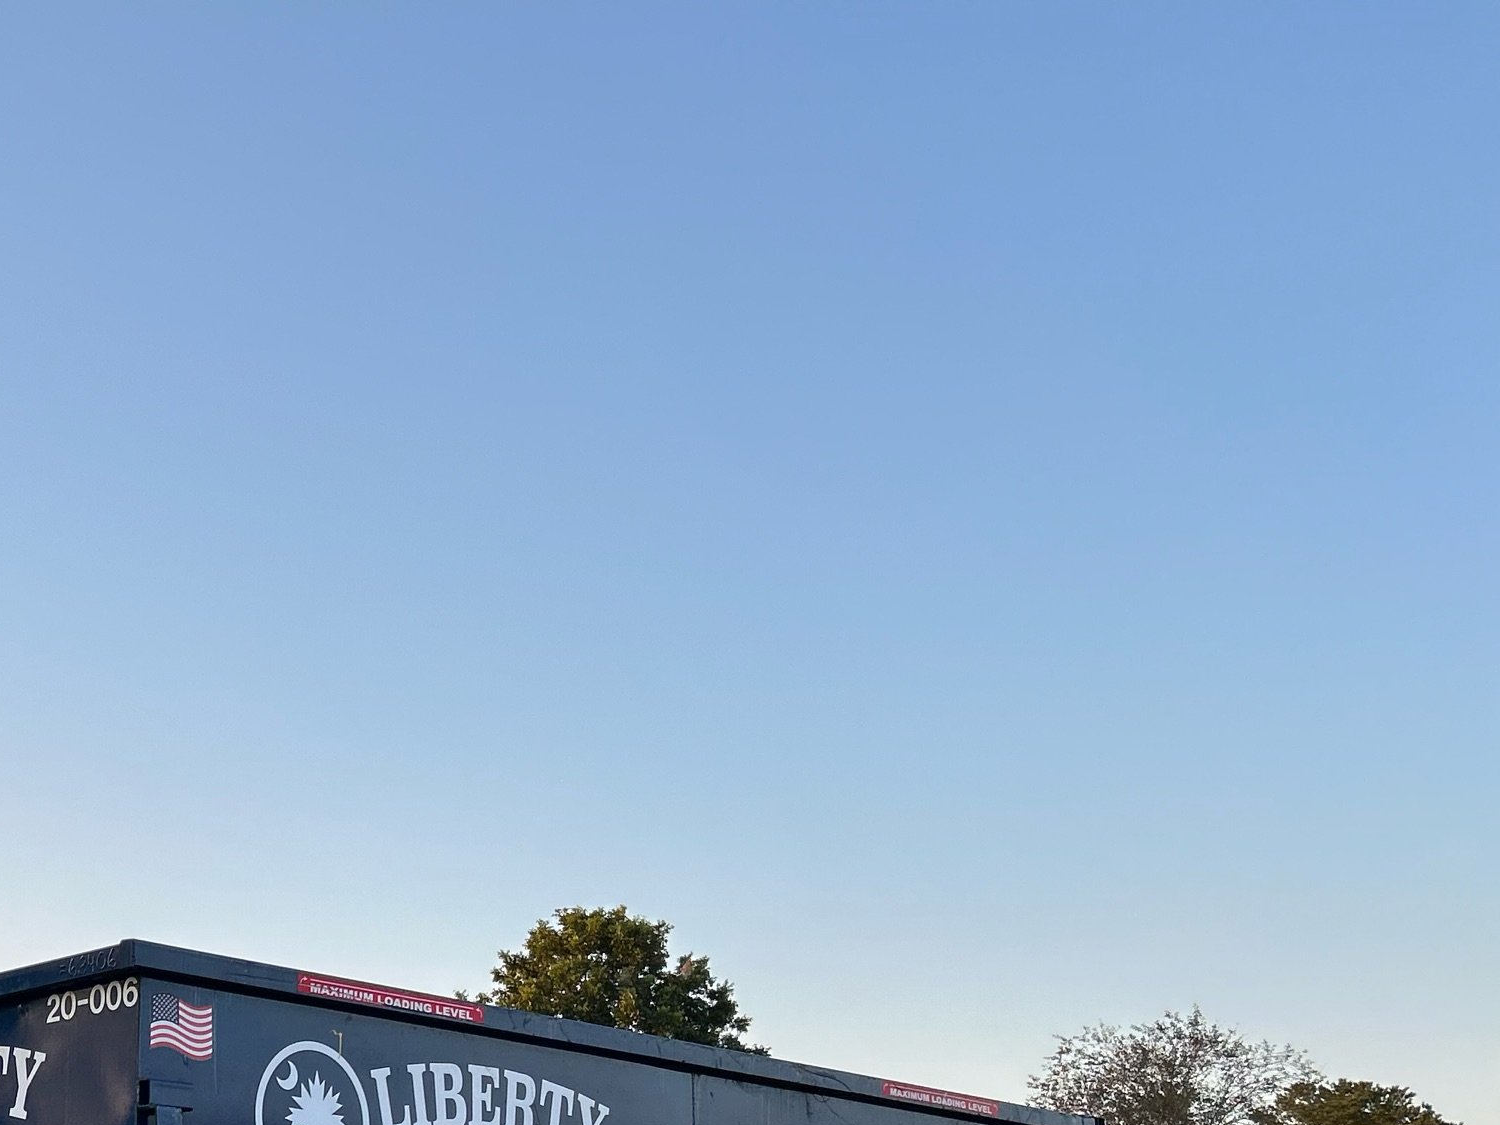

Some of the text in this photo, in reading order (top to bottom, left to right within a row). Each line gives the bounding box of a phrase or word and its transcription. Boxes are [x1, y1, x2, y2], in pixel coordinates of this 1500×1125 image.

[46, 976, 139, 1024] 20-006
[309, 983, 474, 1021] MAXIMUM LOADING LEVEL
[890, 1087, 993, 1114] MAXIMUM LOADING LEVEL
